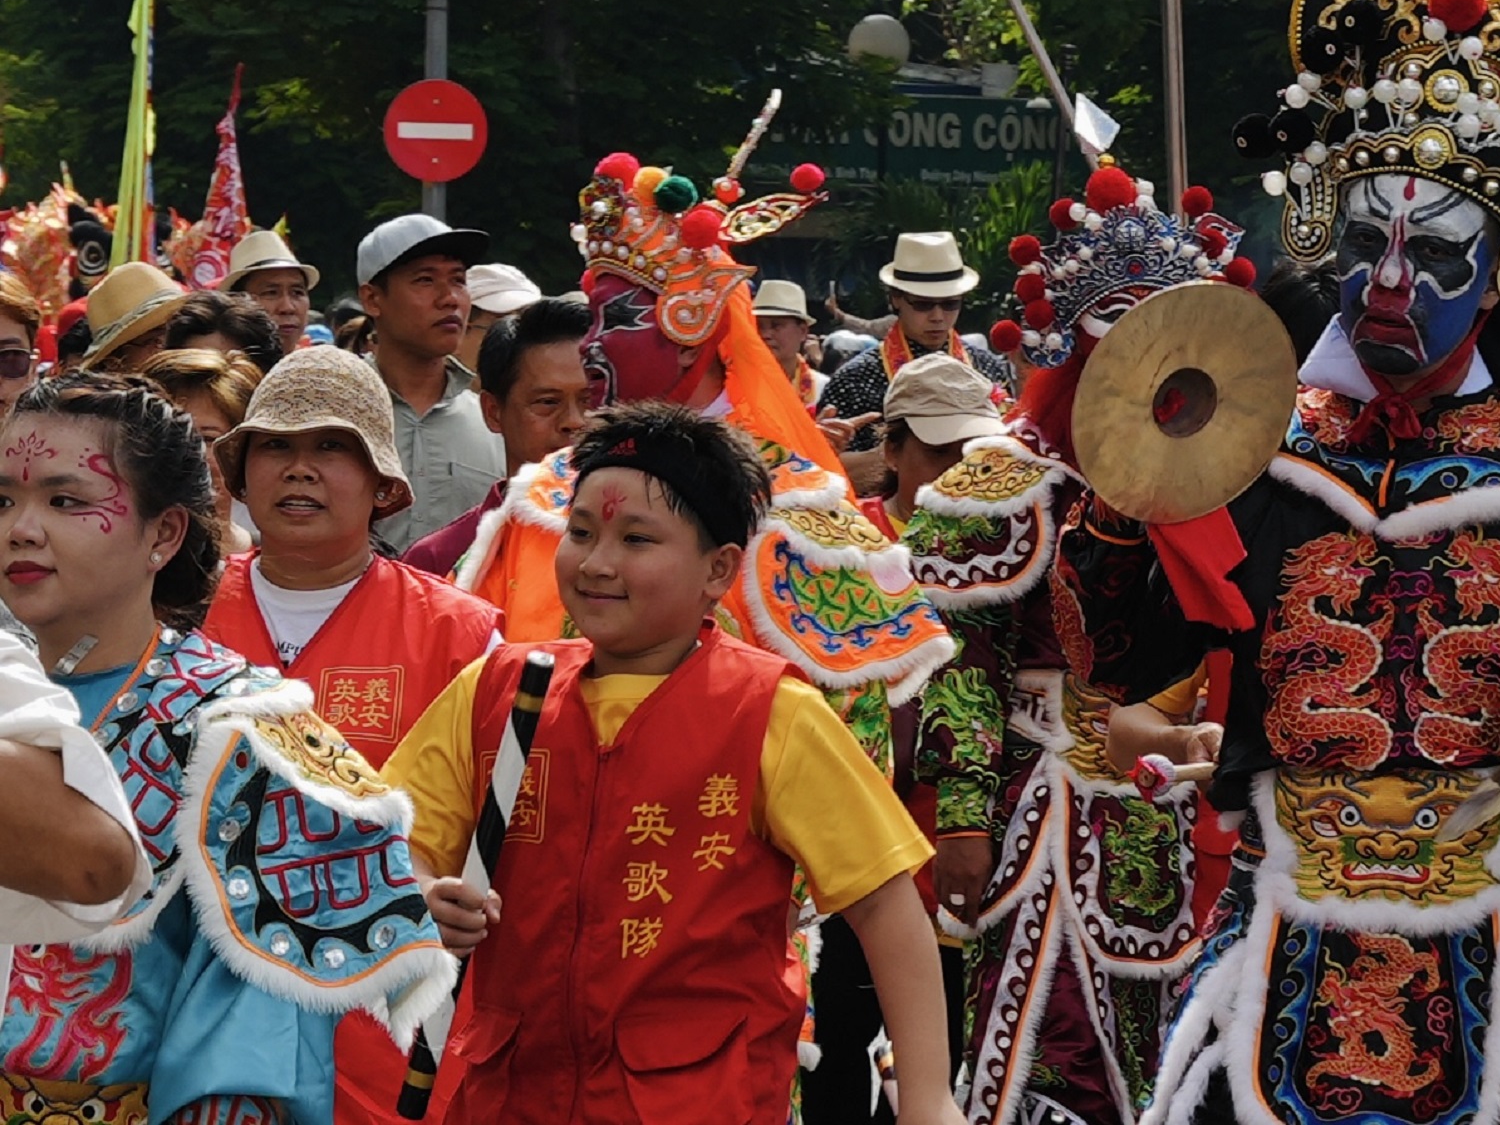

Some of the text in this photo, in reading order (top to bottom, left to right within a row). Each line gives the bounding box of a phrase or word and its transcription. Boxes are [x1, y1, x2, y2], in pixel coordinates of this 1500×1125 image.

[357, 676, 393, 729] 義安
[692, 772, 742, 872] 義安
[619, 801, 677, 960] 英歌隊
